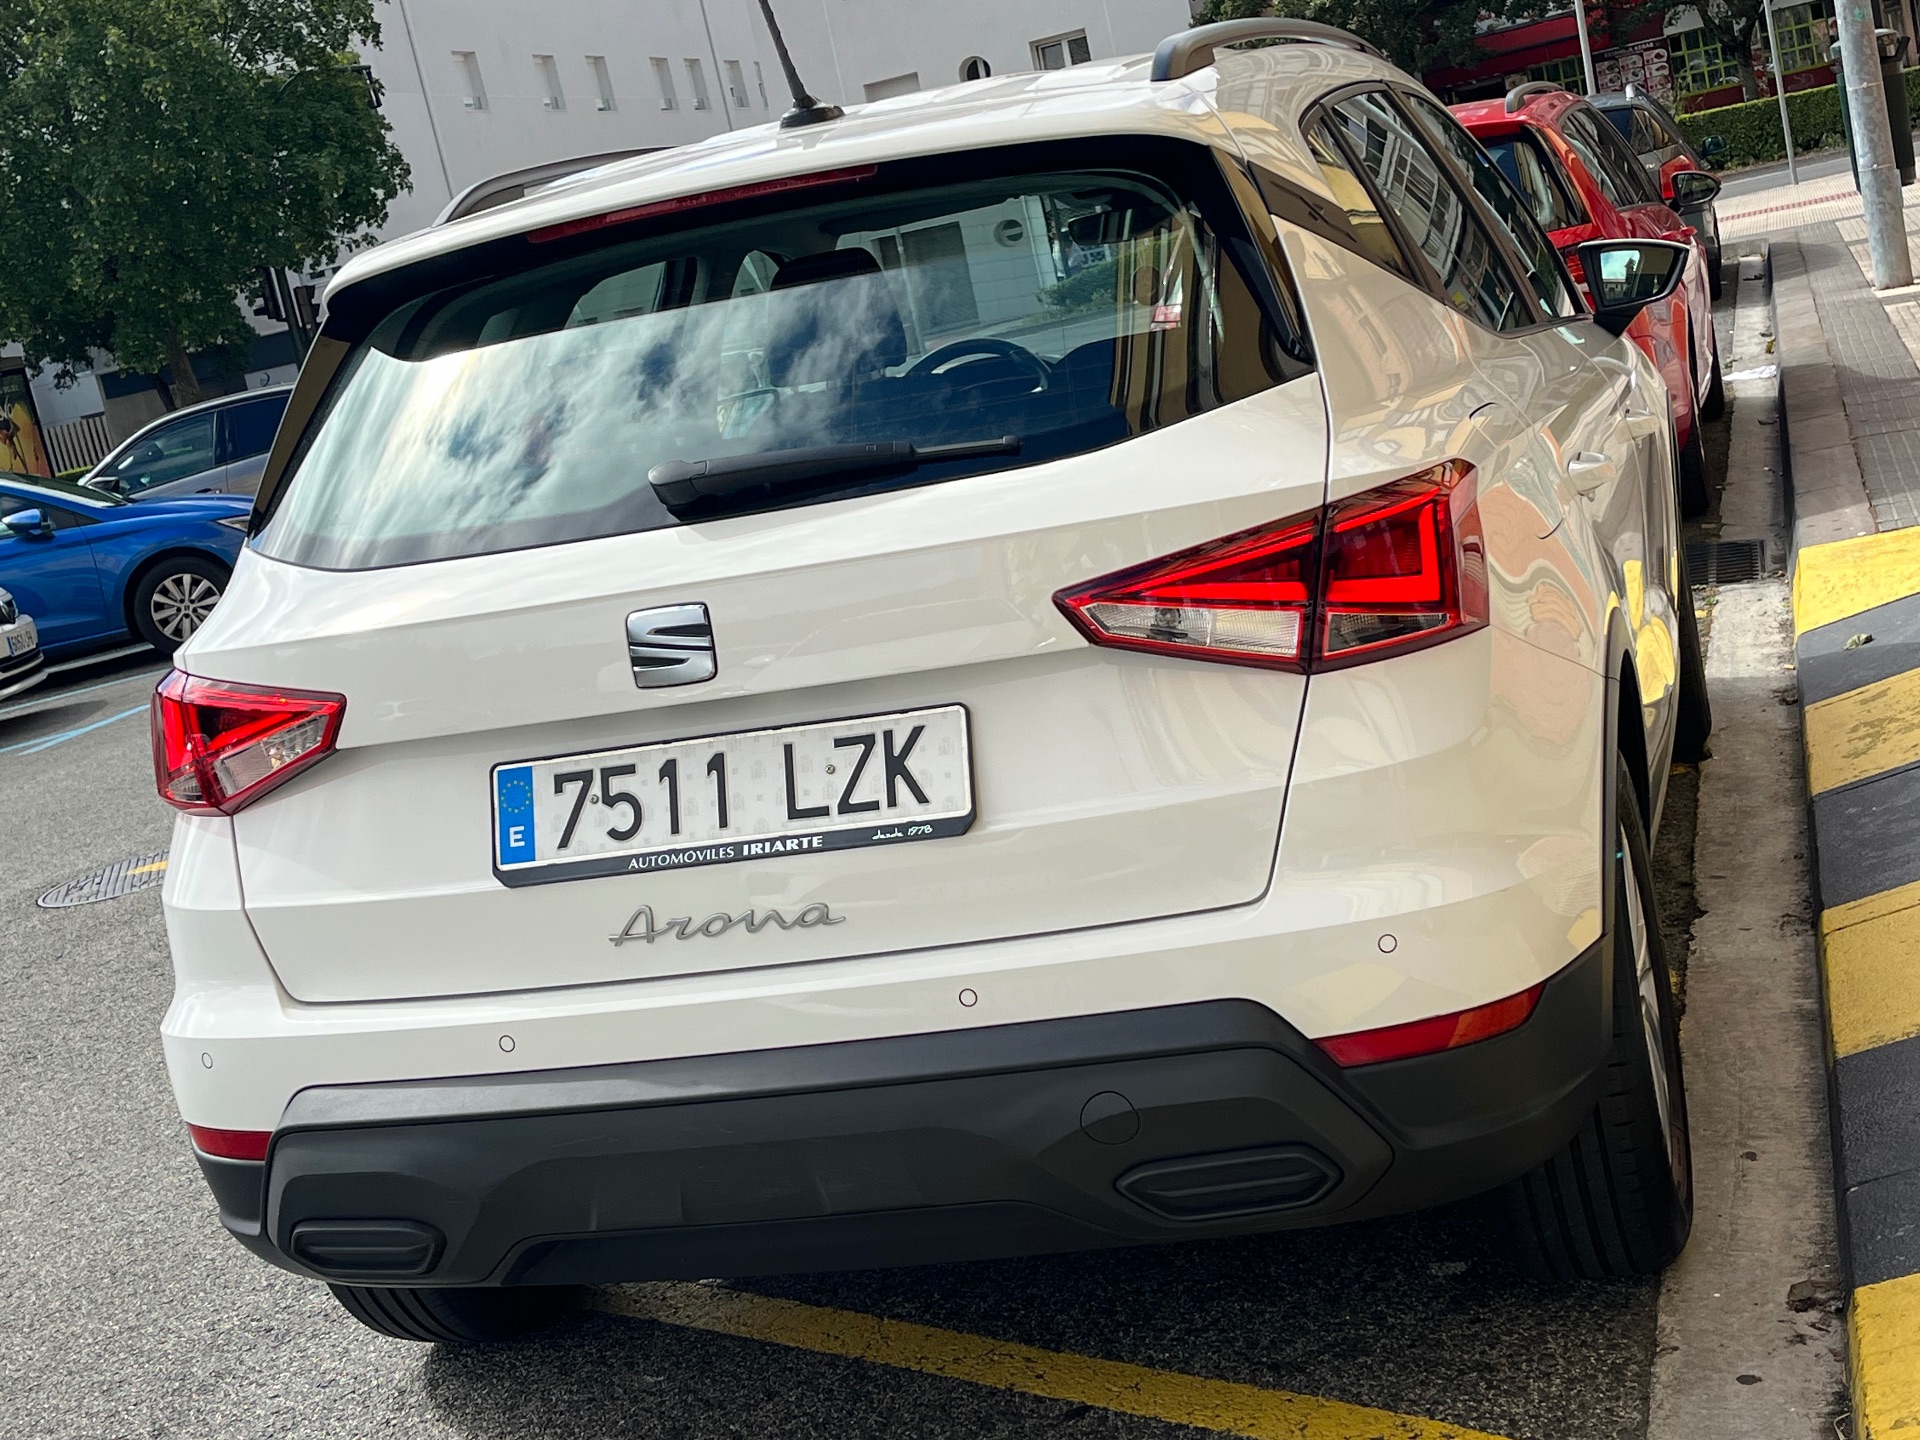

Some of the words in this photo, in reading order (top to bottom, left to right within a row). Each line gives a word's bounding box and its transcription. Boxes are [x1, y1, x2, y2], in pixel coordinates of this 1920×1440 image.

[553, 752, 728, 850] 7511
[784, 725, 930, 820] LZK
[509, 825, 525, 848] E
[742, 835, 824, 857] IRIARTE
[906, 823, 933, 836] 1978
[608, 902, 847, 947] Arona
